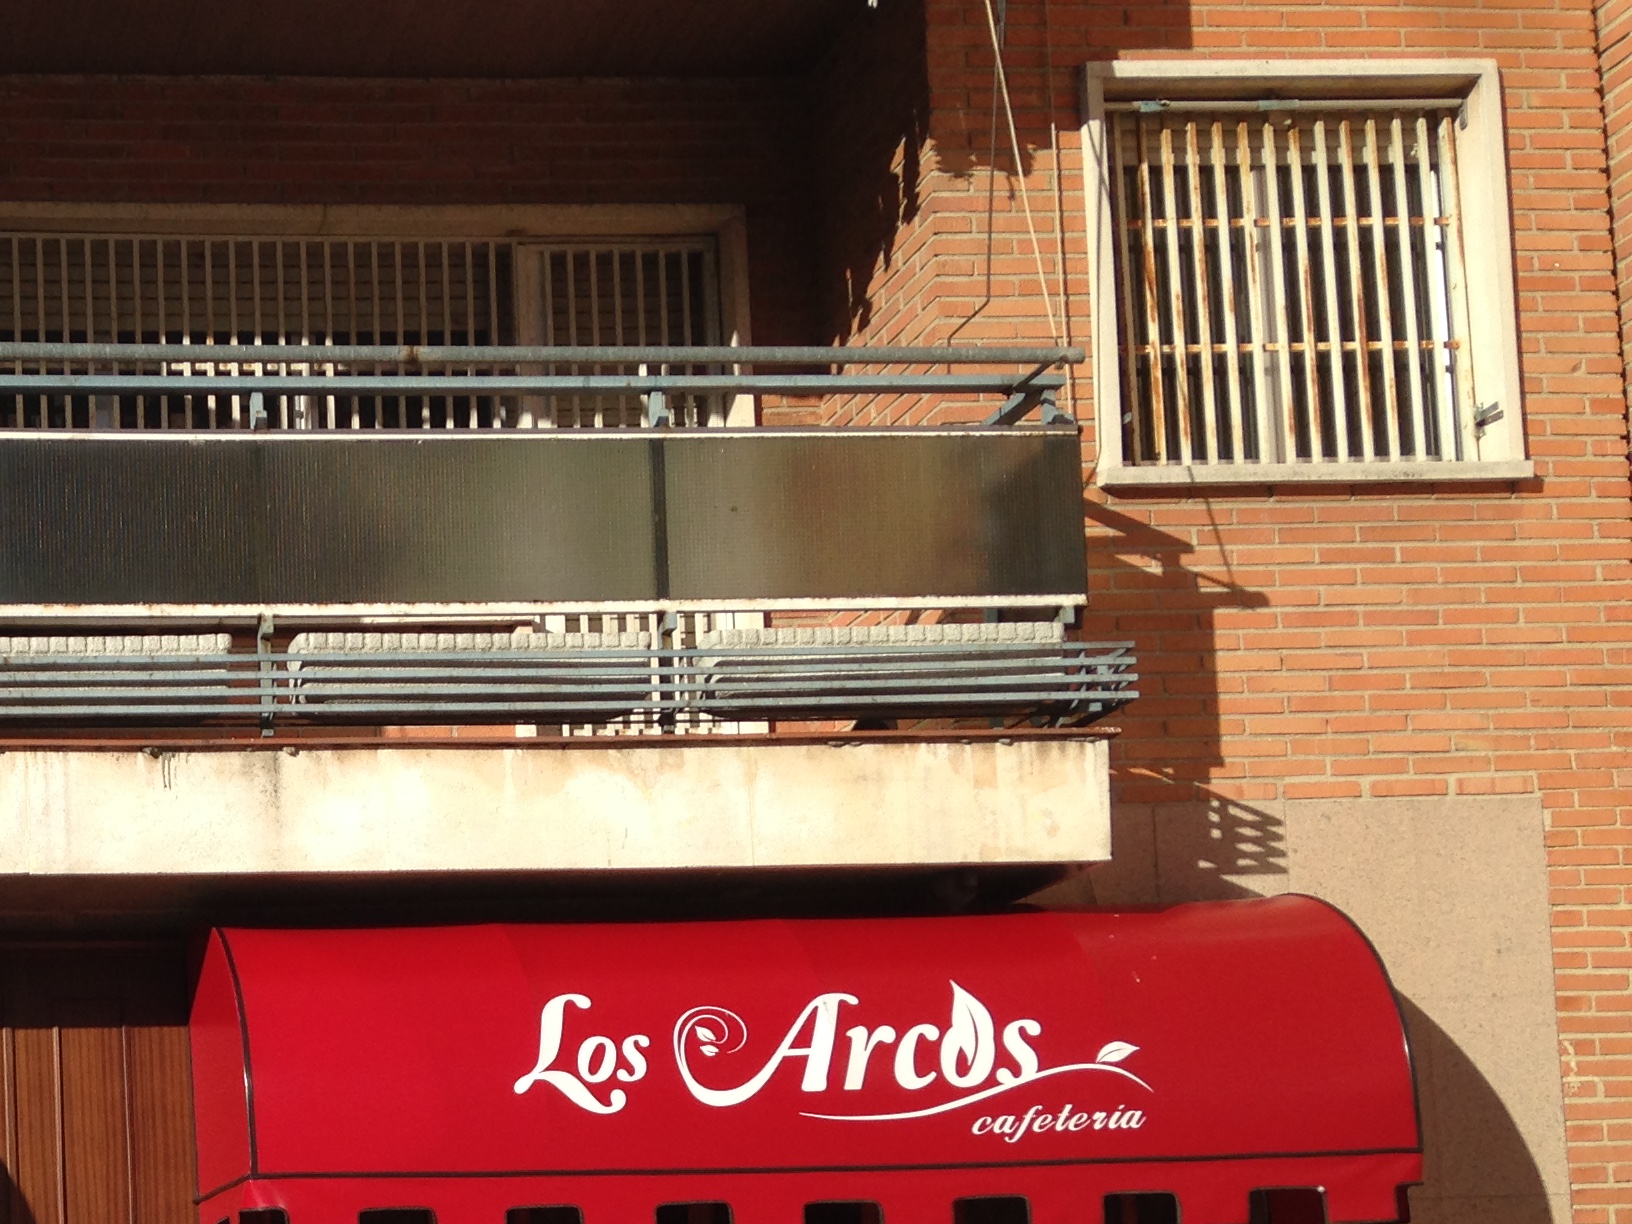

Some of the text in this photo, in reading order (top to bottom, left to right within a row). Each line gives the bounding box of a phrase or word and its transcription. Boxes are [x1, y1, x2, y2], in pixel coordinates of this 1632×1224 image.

[514, 980, 1043, 1115] Los Arcos
[972, 1103, 1148, 1144] cafetería
